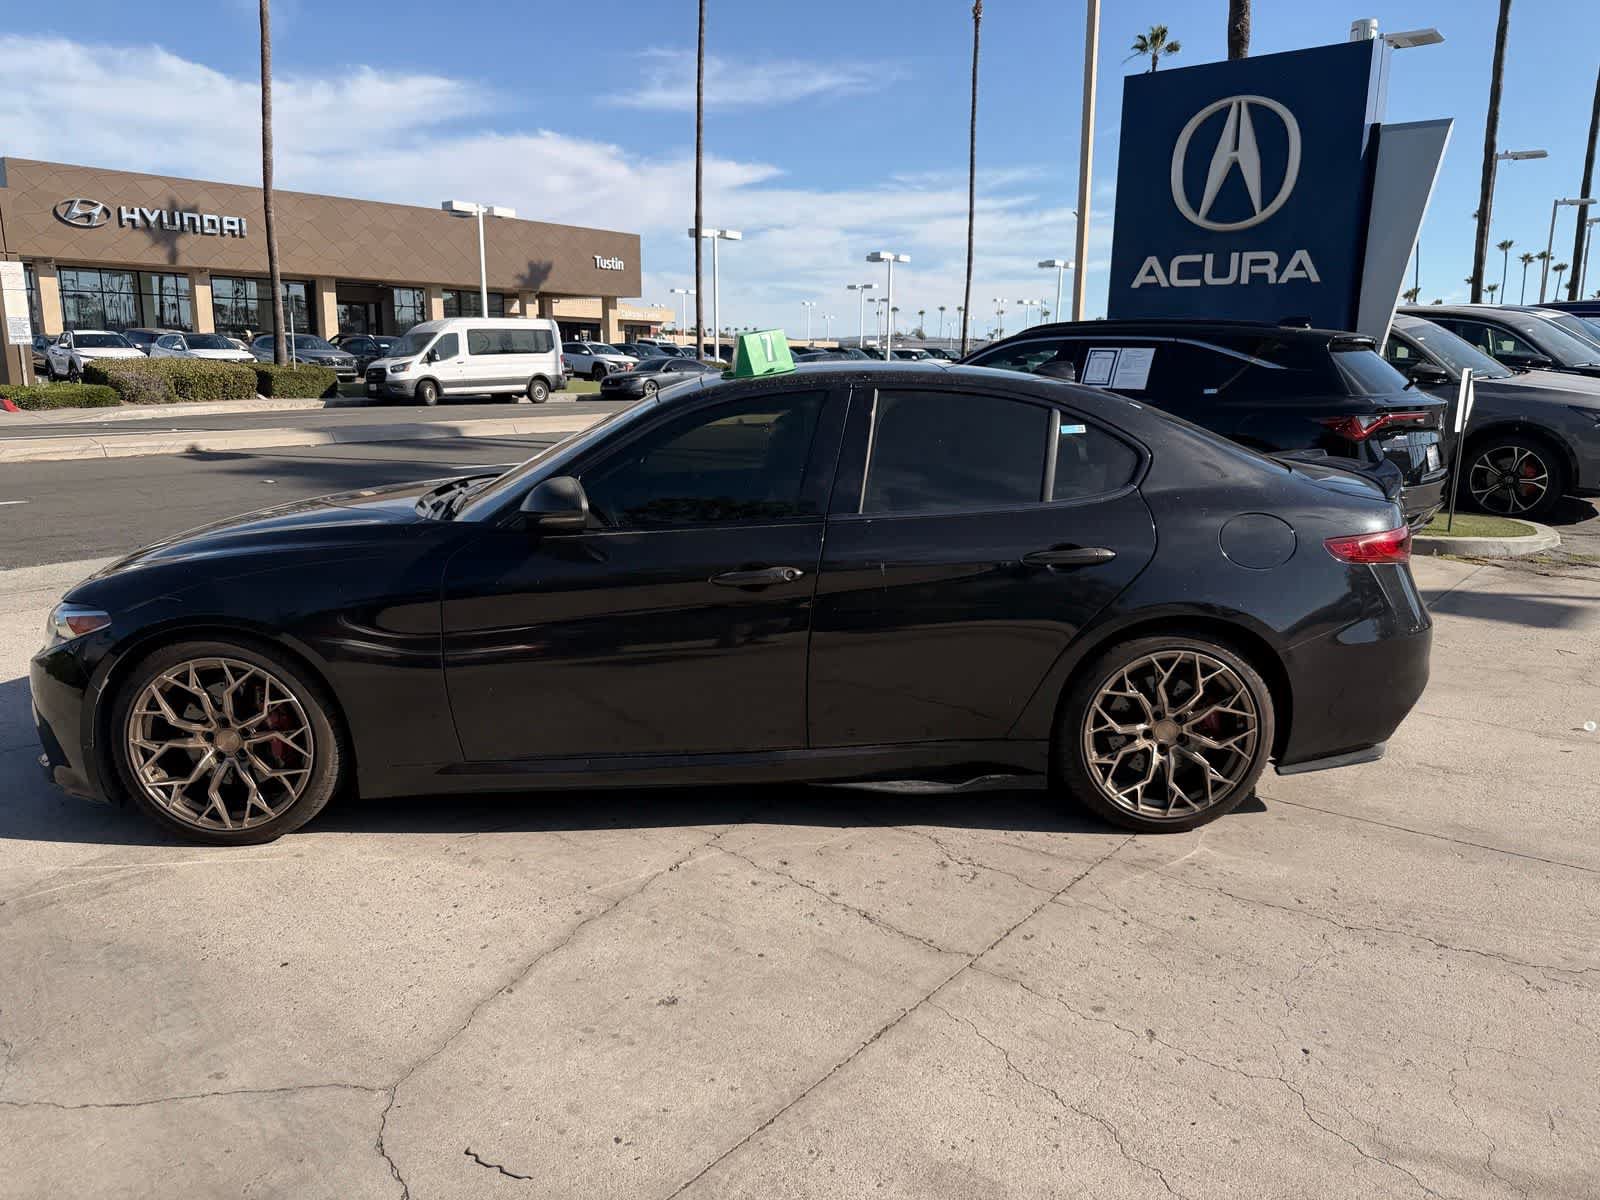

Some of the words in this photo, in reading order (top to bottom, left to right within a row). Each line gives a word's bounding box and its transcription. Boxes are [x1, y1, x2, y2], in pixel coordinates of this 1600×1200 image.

[119, 205, 247, 238] HYUNDAI
[593, 255, 625, 270] Tustin
[1130, 249, 1321, 289] ACURA
